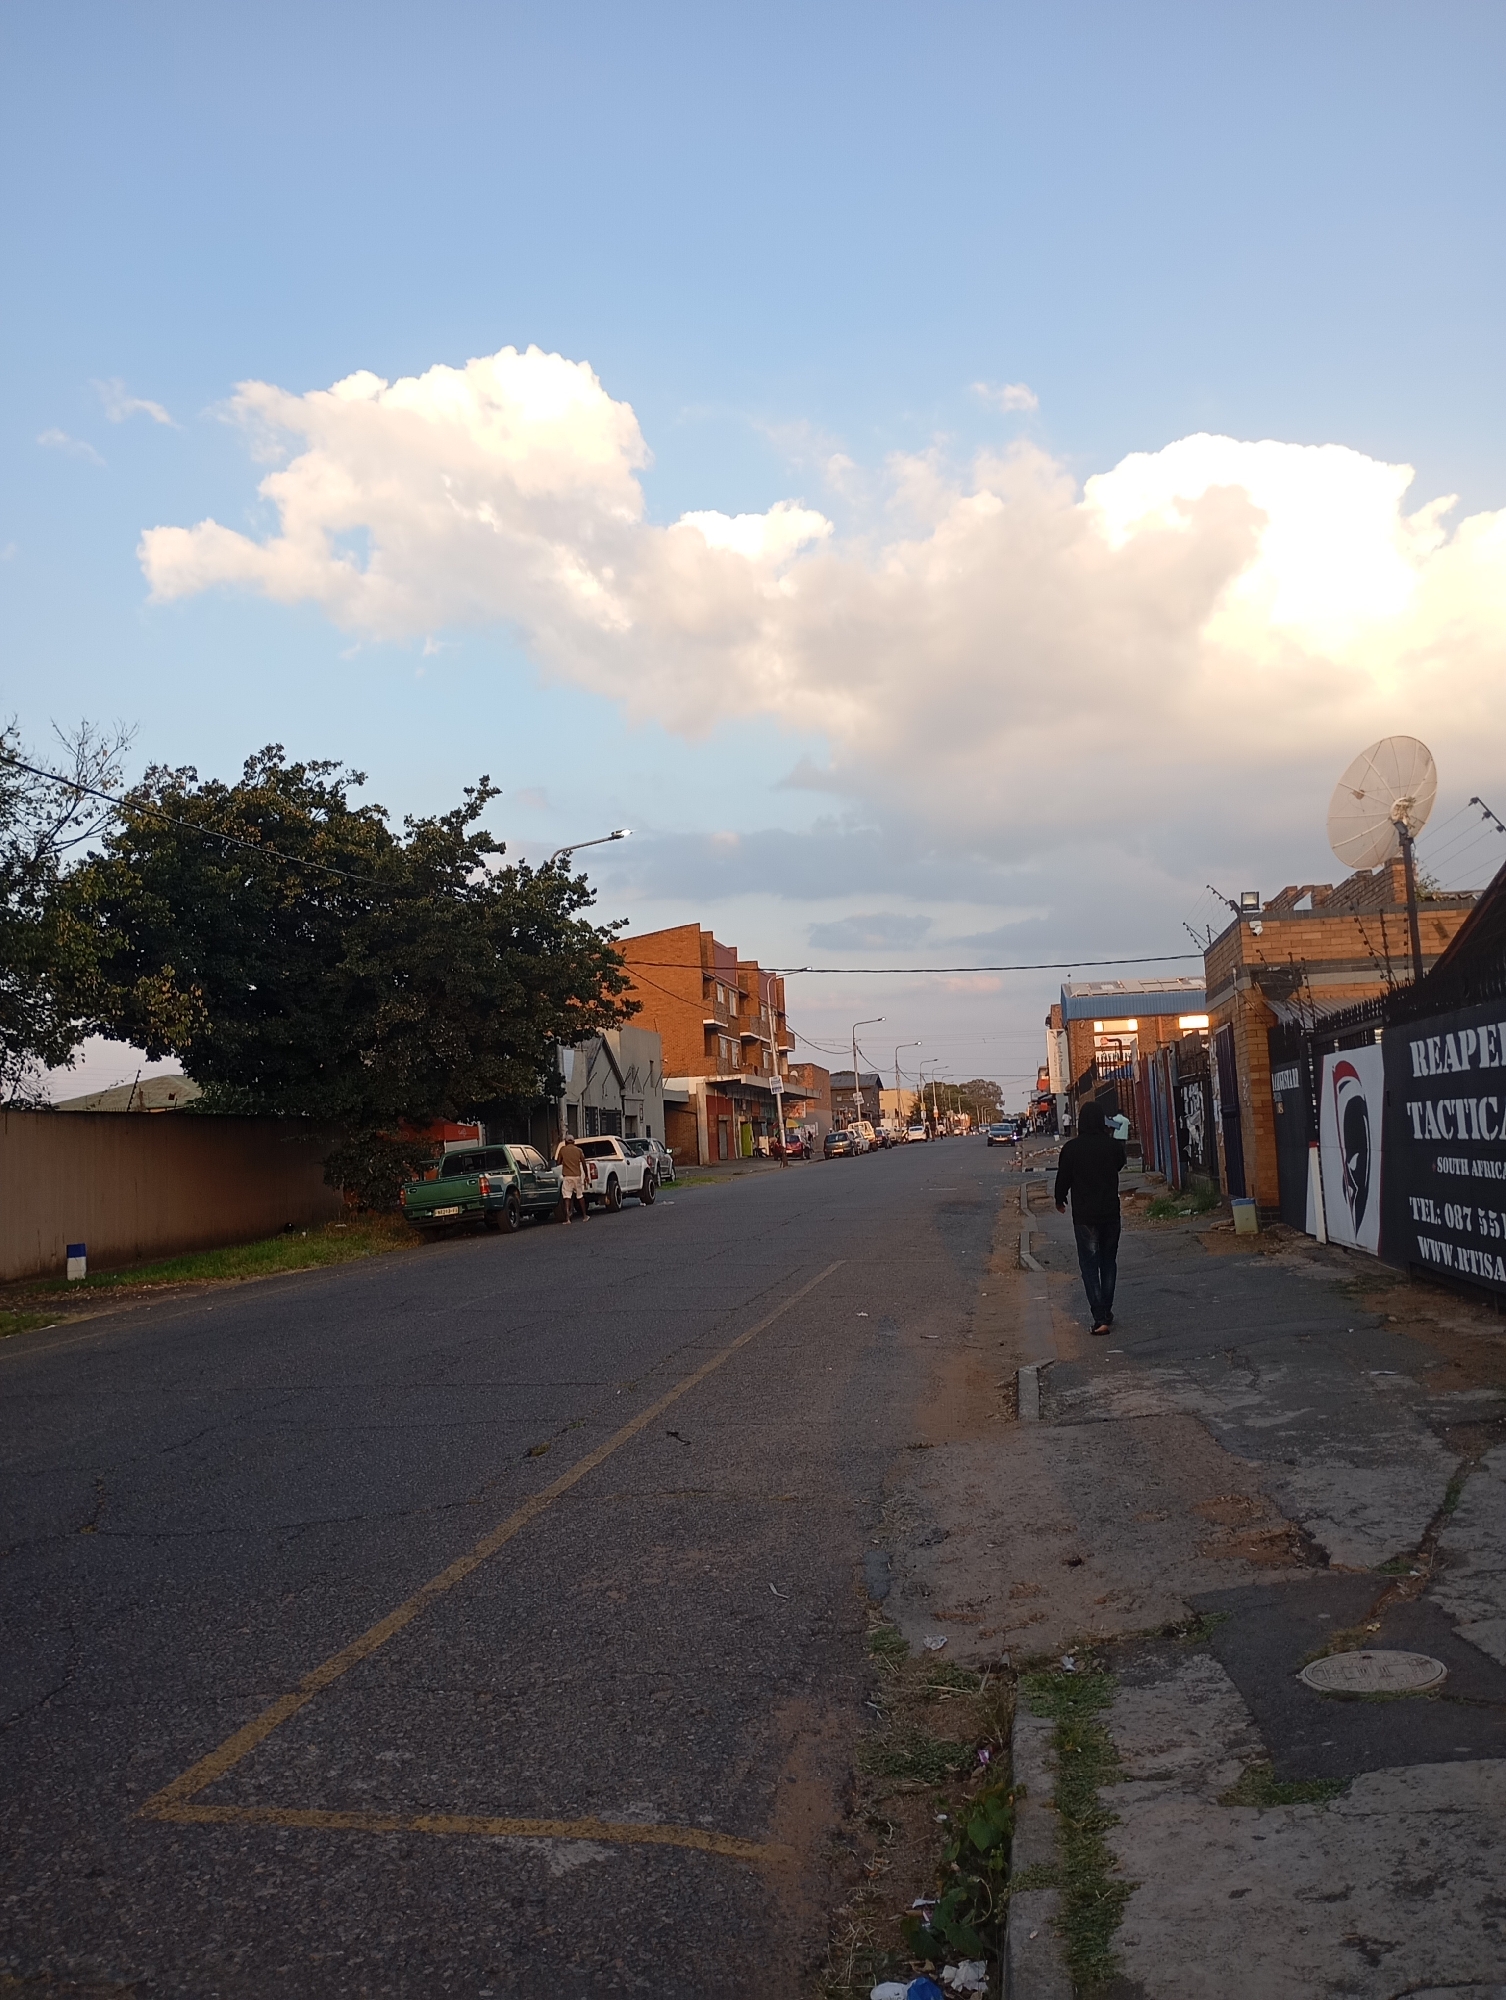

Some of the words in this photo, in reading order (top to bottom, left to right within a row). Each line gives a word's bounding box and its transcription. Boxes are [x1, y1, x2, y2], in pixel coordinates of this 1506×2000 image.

[1437, 1157, 1469, 1175] SOUTH
[1409, 1197, 1441, 1224] TEL:
[1444, 1203, 1472, 1231] 087
[1417, 1236, 1506, 1282] WWW.RTISA
